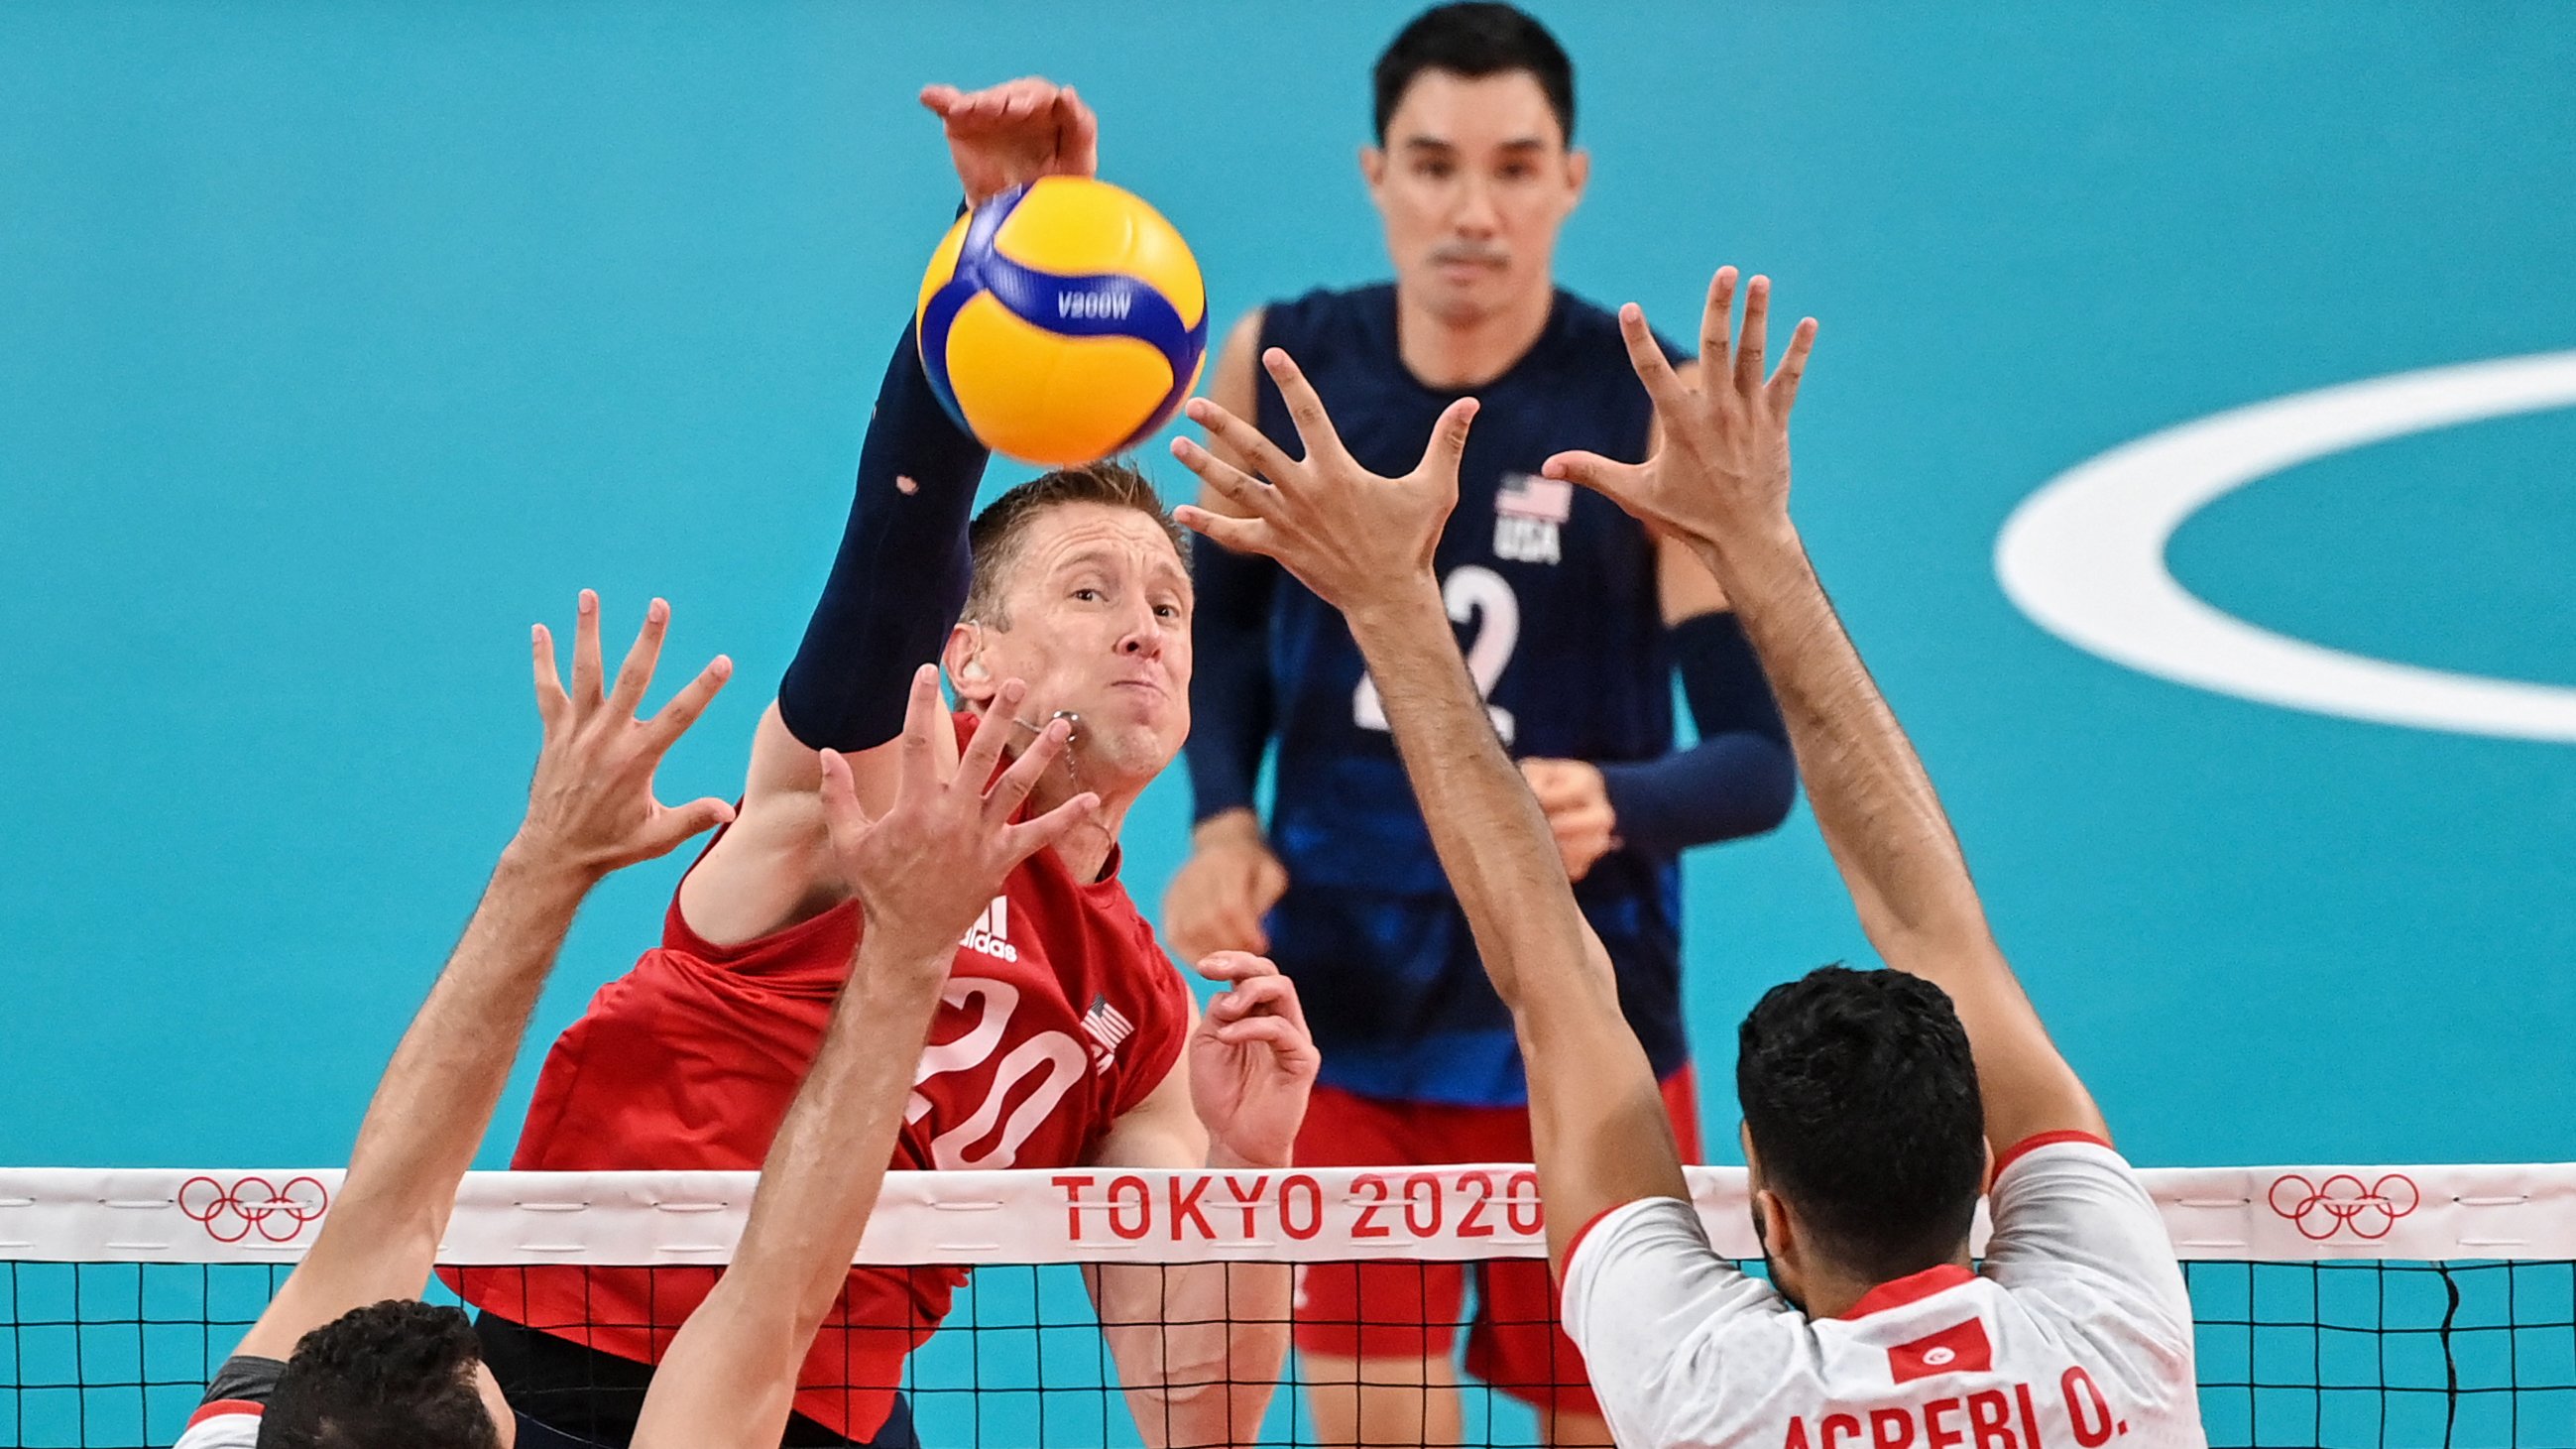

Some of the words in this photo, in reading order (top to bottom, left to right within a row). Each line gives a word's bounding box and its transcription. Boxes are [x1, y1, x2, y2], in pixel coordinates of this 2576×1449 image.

[1493, 517, 1562, 565] USA
[1352, 564, 1520, 745] 2
[958, 926, 1017, 963] didas
[904, 976, 1089, 1171] 20
[1052, 1174, 1324, 1242] TOKYO
[1349, 1171, 1545, 1239] 2020
